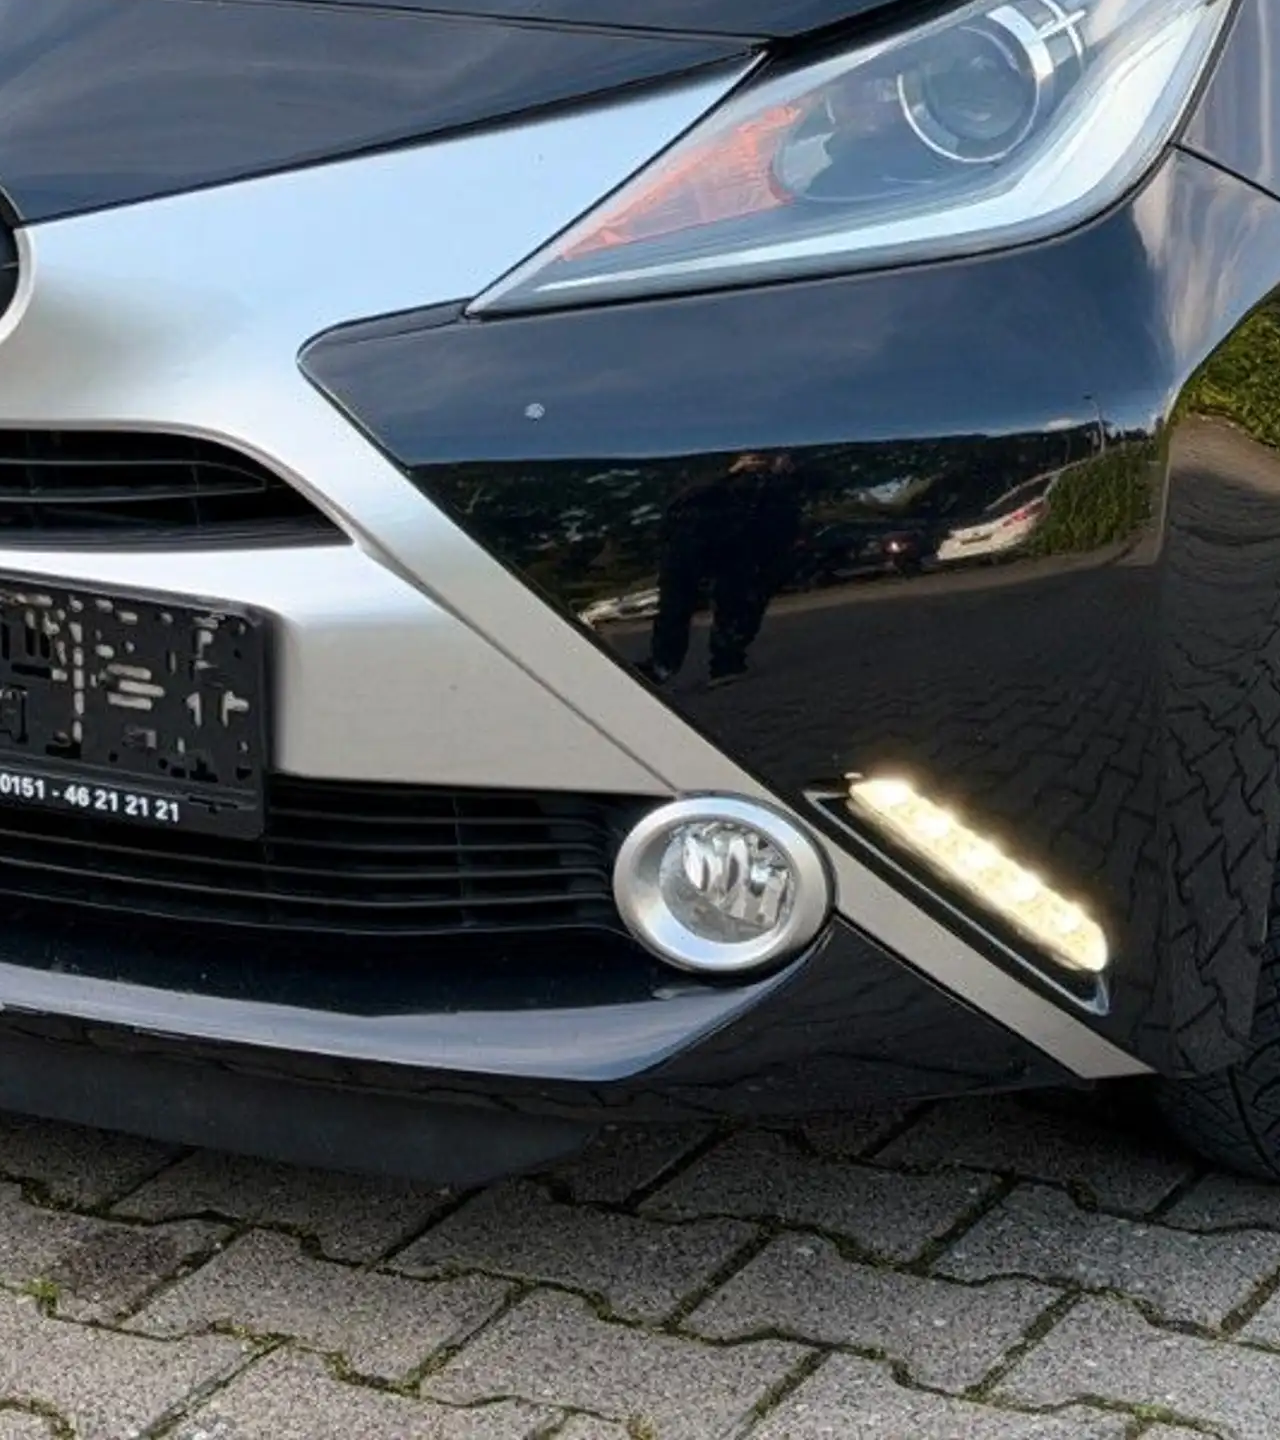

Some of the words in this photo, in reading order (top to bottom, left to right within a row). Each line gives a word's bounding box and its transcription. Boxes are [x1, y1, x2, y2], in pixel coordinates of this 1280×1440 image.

[63, 786, 89, 808] 46
[93, 790, 118, 812] 21
[124, 794, 149, 817] 21
[155, 800, 179, 823] 21
